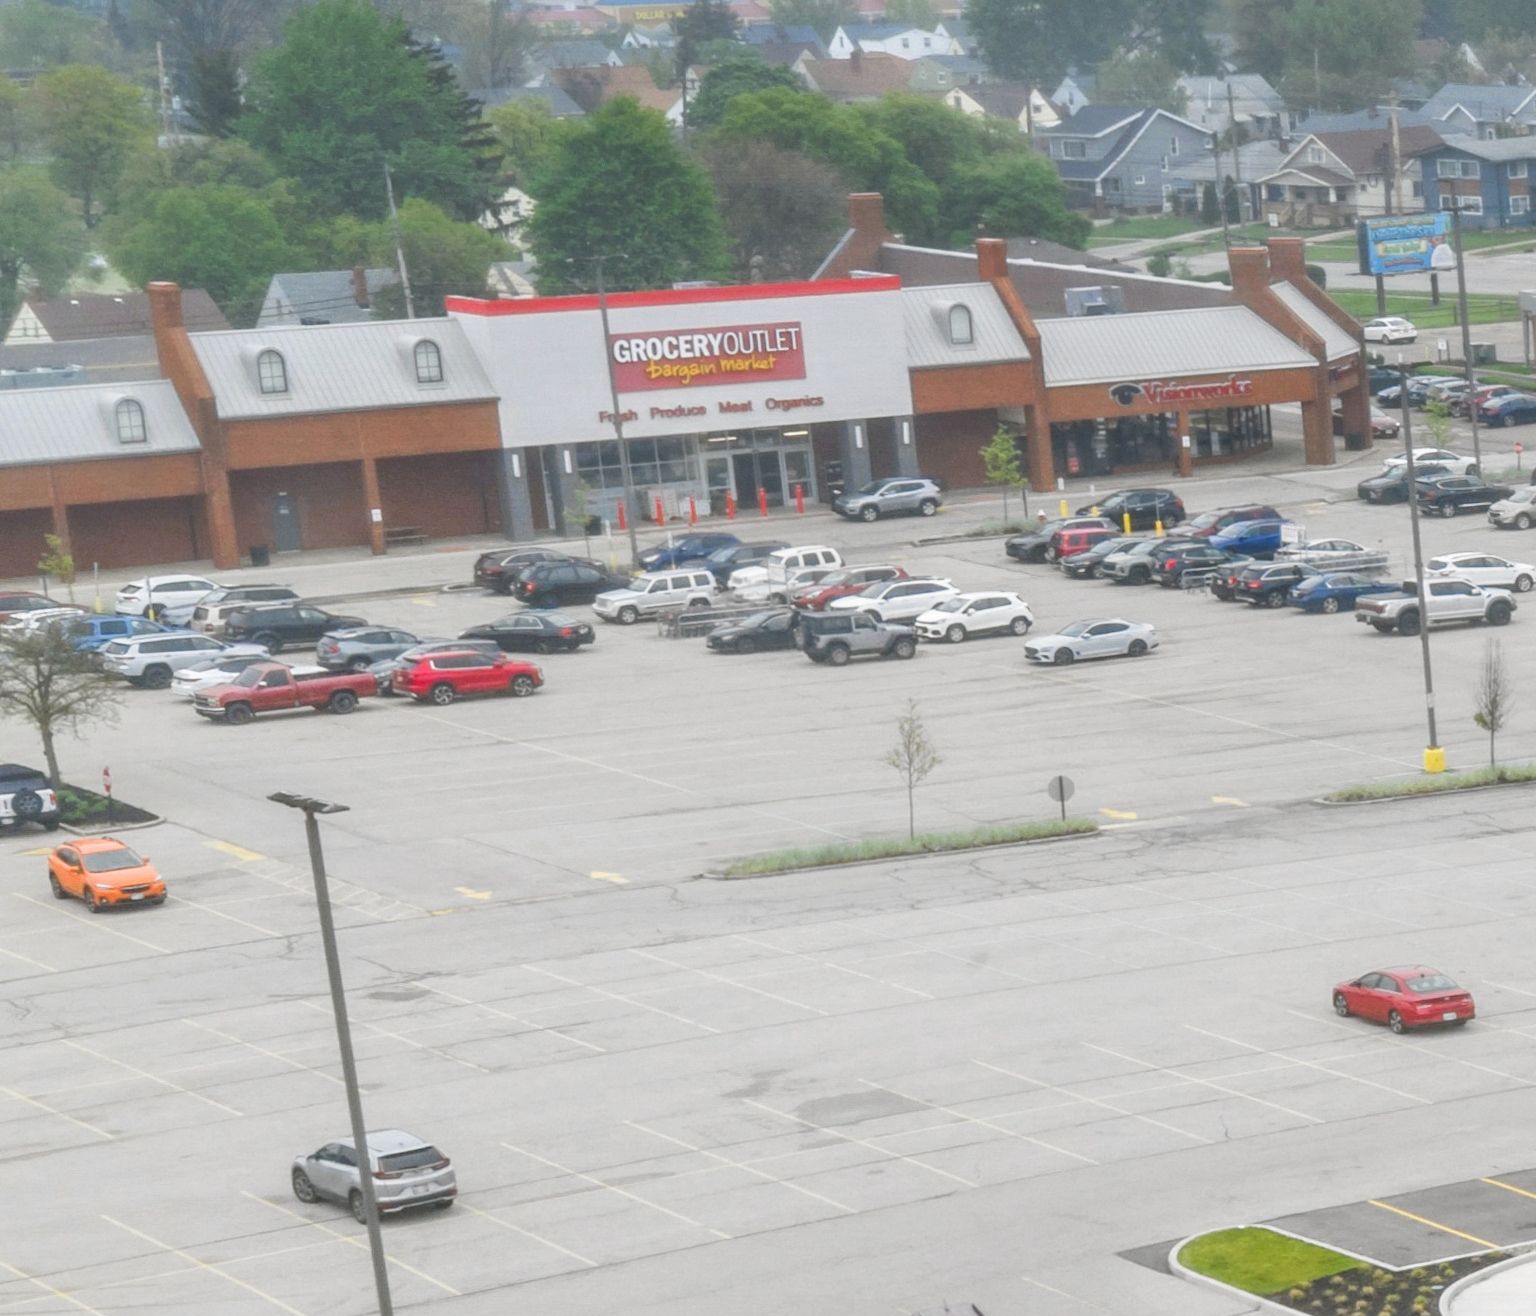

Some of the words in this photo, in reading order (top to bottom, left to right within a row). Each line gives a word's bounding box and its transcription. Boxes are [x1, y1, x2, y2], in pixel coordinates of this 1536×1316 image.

[646, 359, 716, 384] bargain
[720, 356, 776, 373] market
[650, 404, 707, 420] Produce
[719, 401, 752, 414] Meat
[766, 395, 824, 412] Organics
